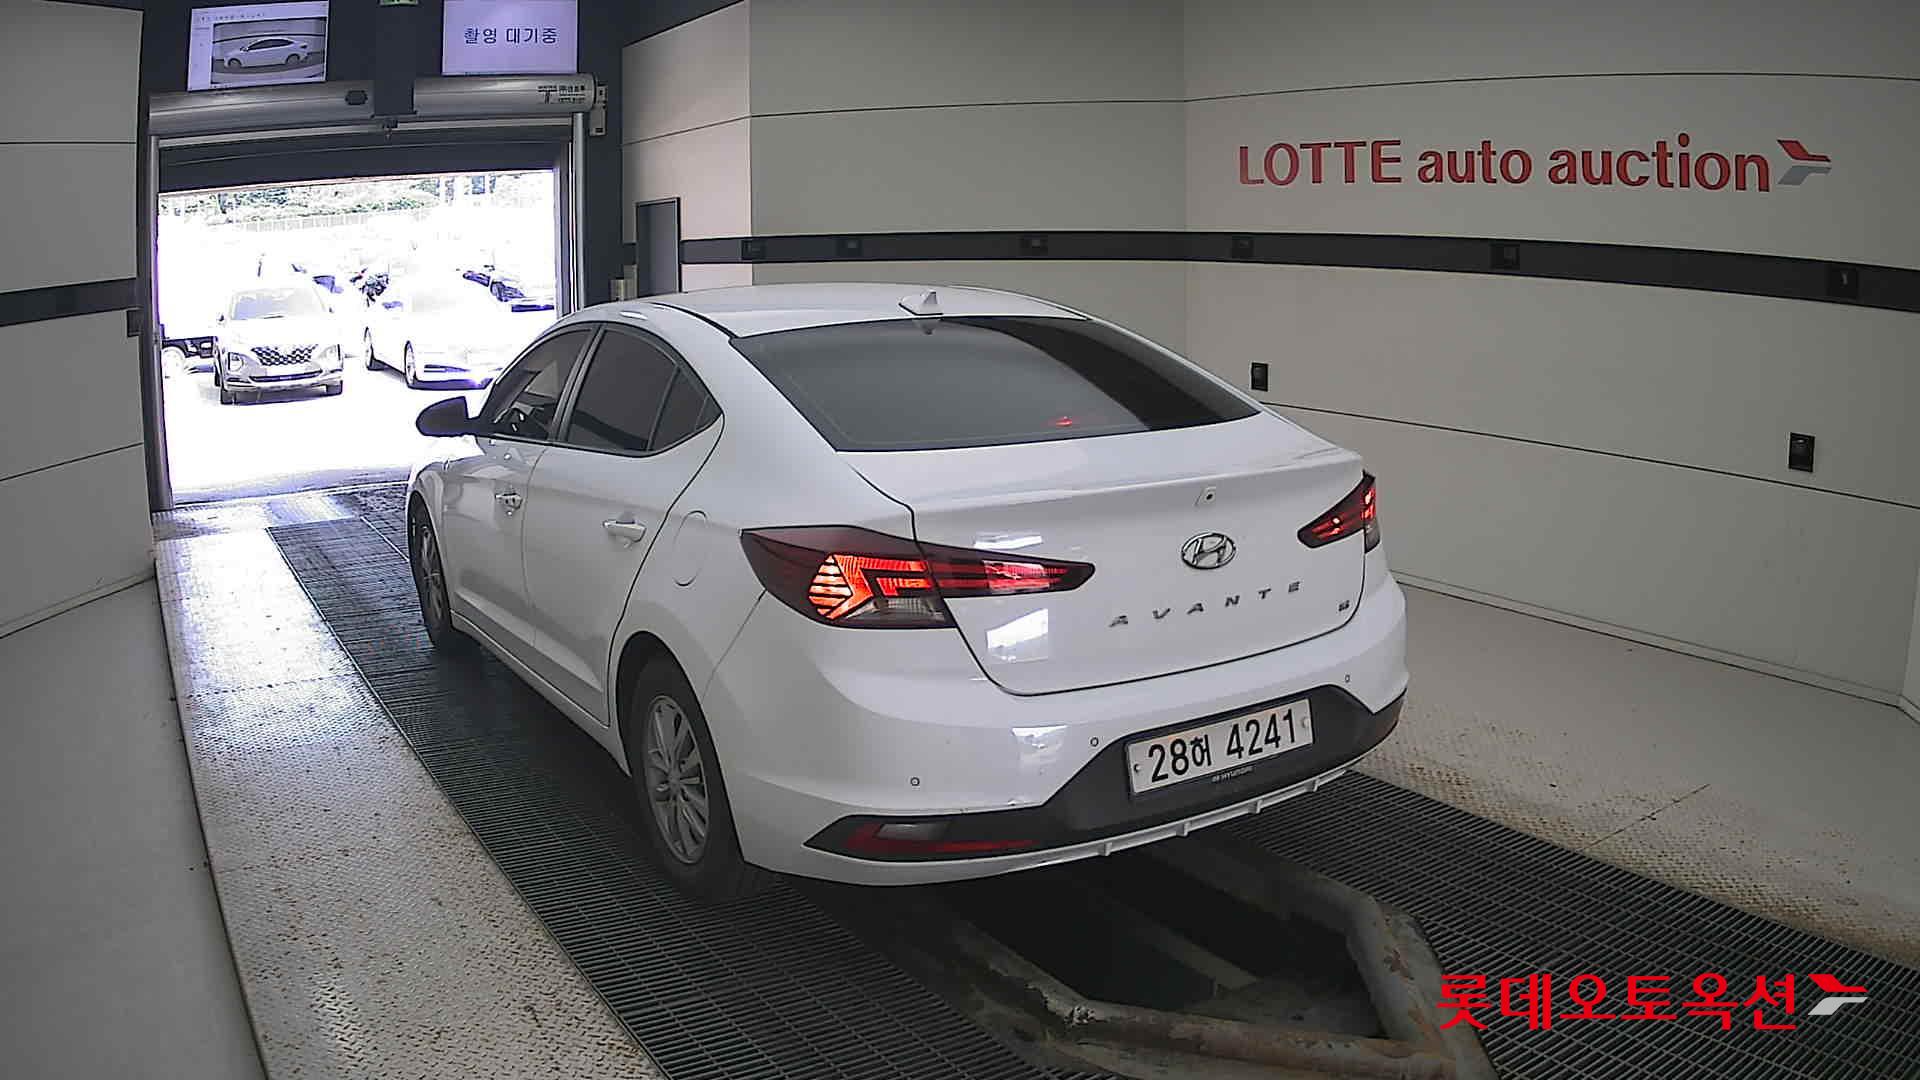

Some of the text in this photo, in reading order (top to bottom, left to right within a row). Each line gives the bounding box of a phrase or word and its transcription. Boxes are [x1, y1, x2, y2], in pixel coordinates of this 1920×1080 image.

[506, 28, 558, 44] 대기중
[1240, 133, 1770, 192] LOTTE auto auction
[1108, 581, 1301, 627] AVANTE
[1148, 709, 1296, 783] 28허 4241
